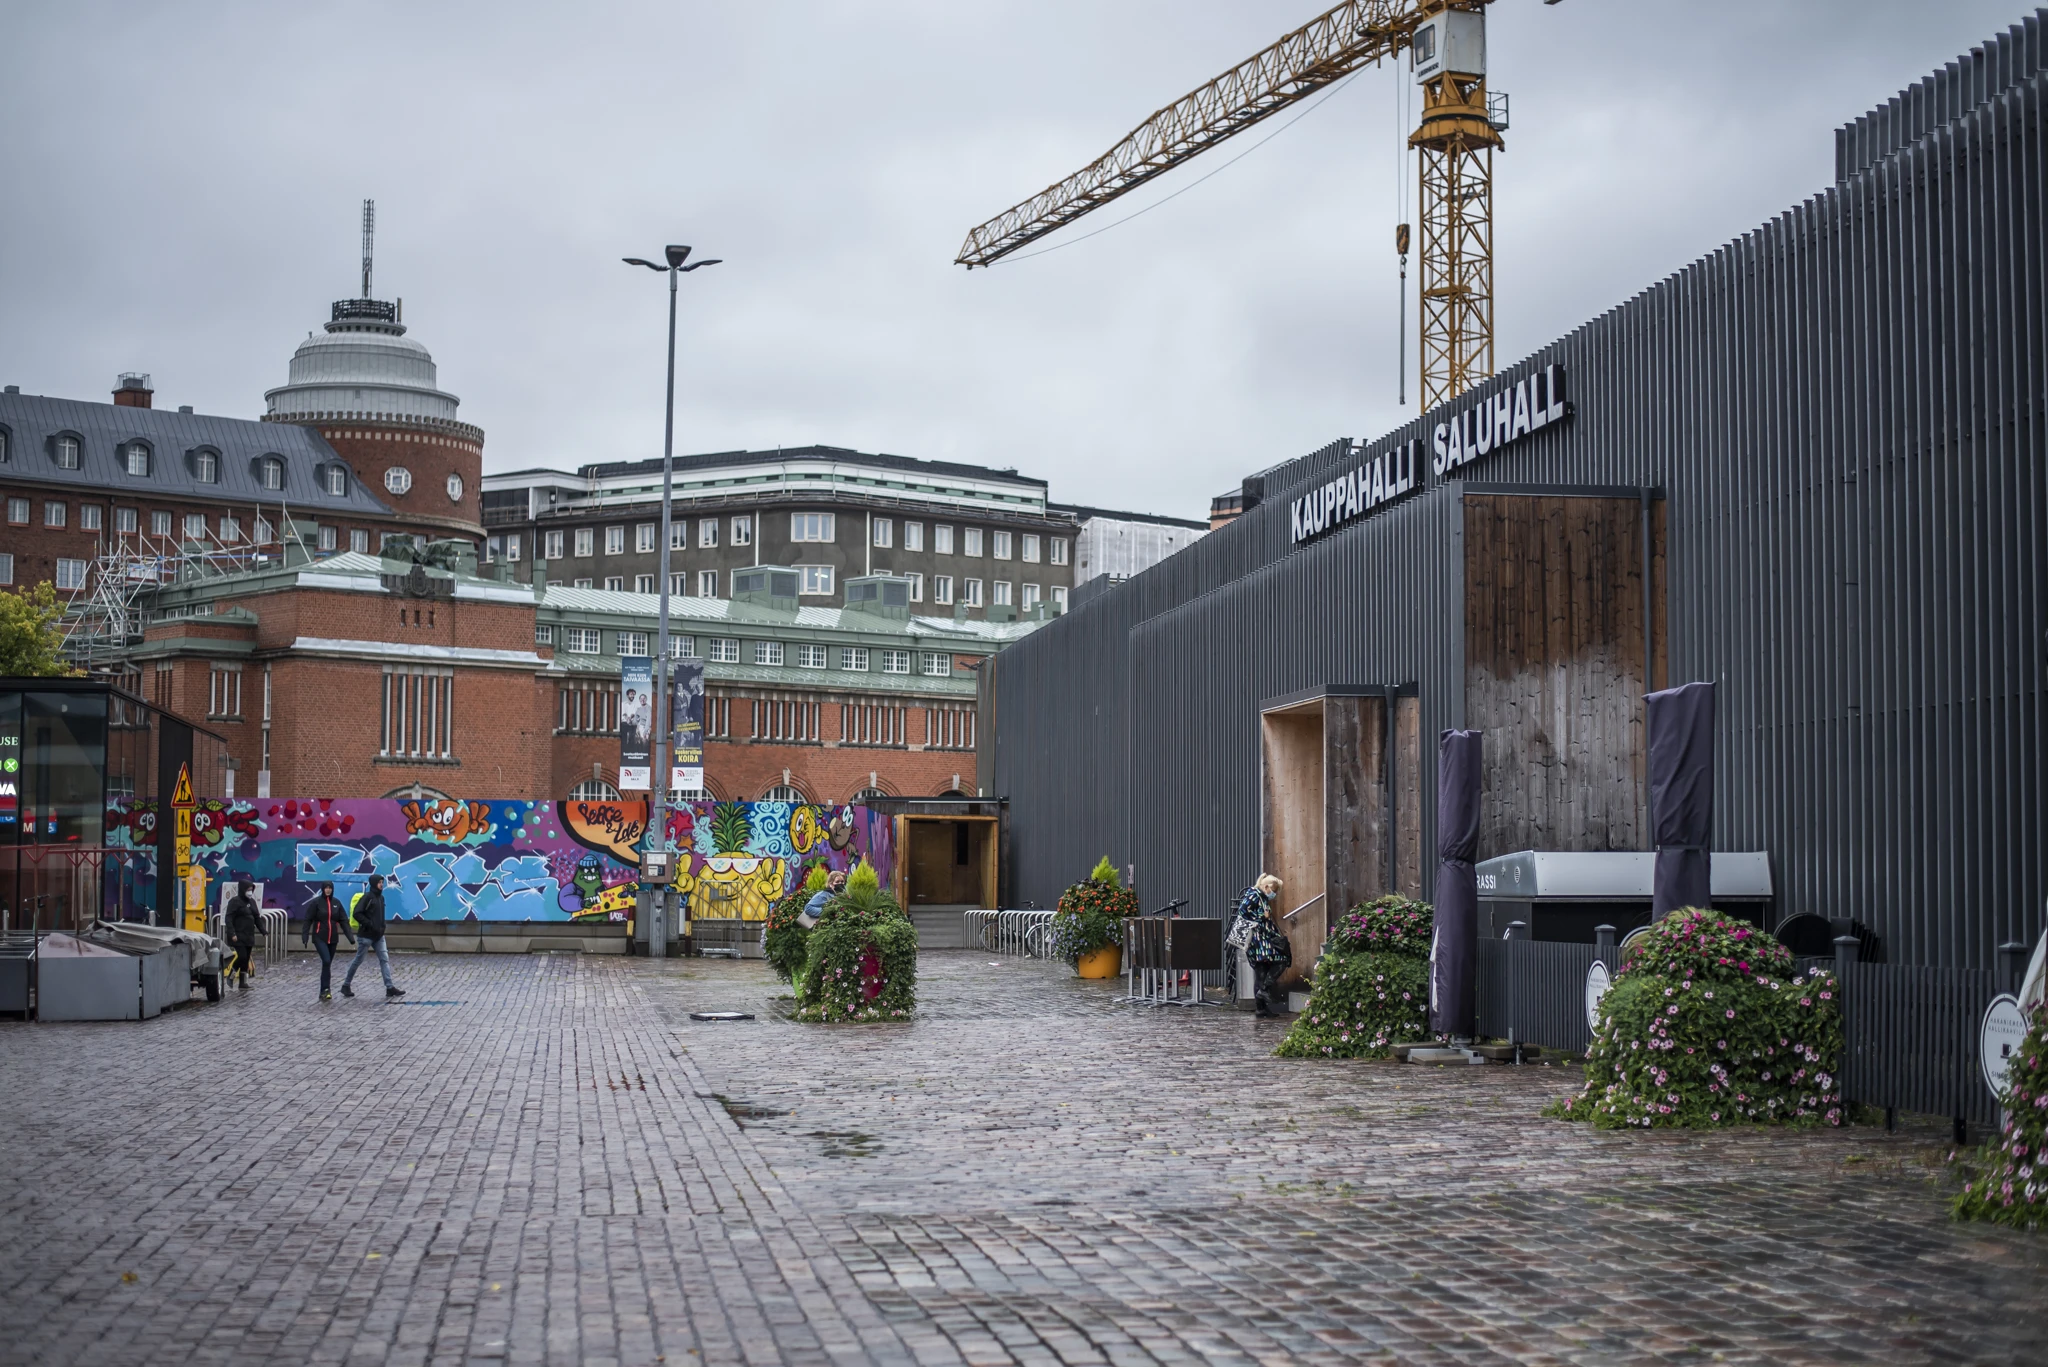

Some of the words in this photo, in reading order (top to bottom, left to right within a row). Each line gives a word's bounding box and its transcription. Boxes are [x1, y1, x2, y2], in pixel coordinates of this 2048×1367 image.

[1291, 438, 1416, 544] KAUPPAHALLI
[1433, 364, 1565, 476] SALUHALL
[678, 755, 699, 763] KOIRA
[1990, 1017, 2023, 1027] HAKANIEMEN
[1988, 1025, 2025, 1036] HALLIKAHVILA
